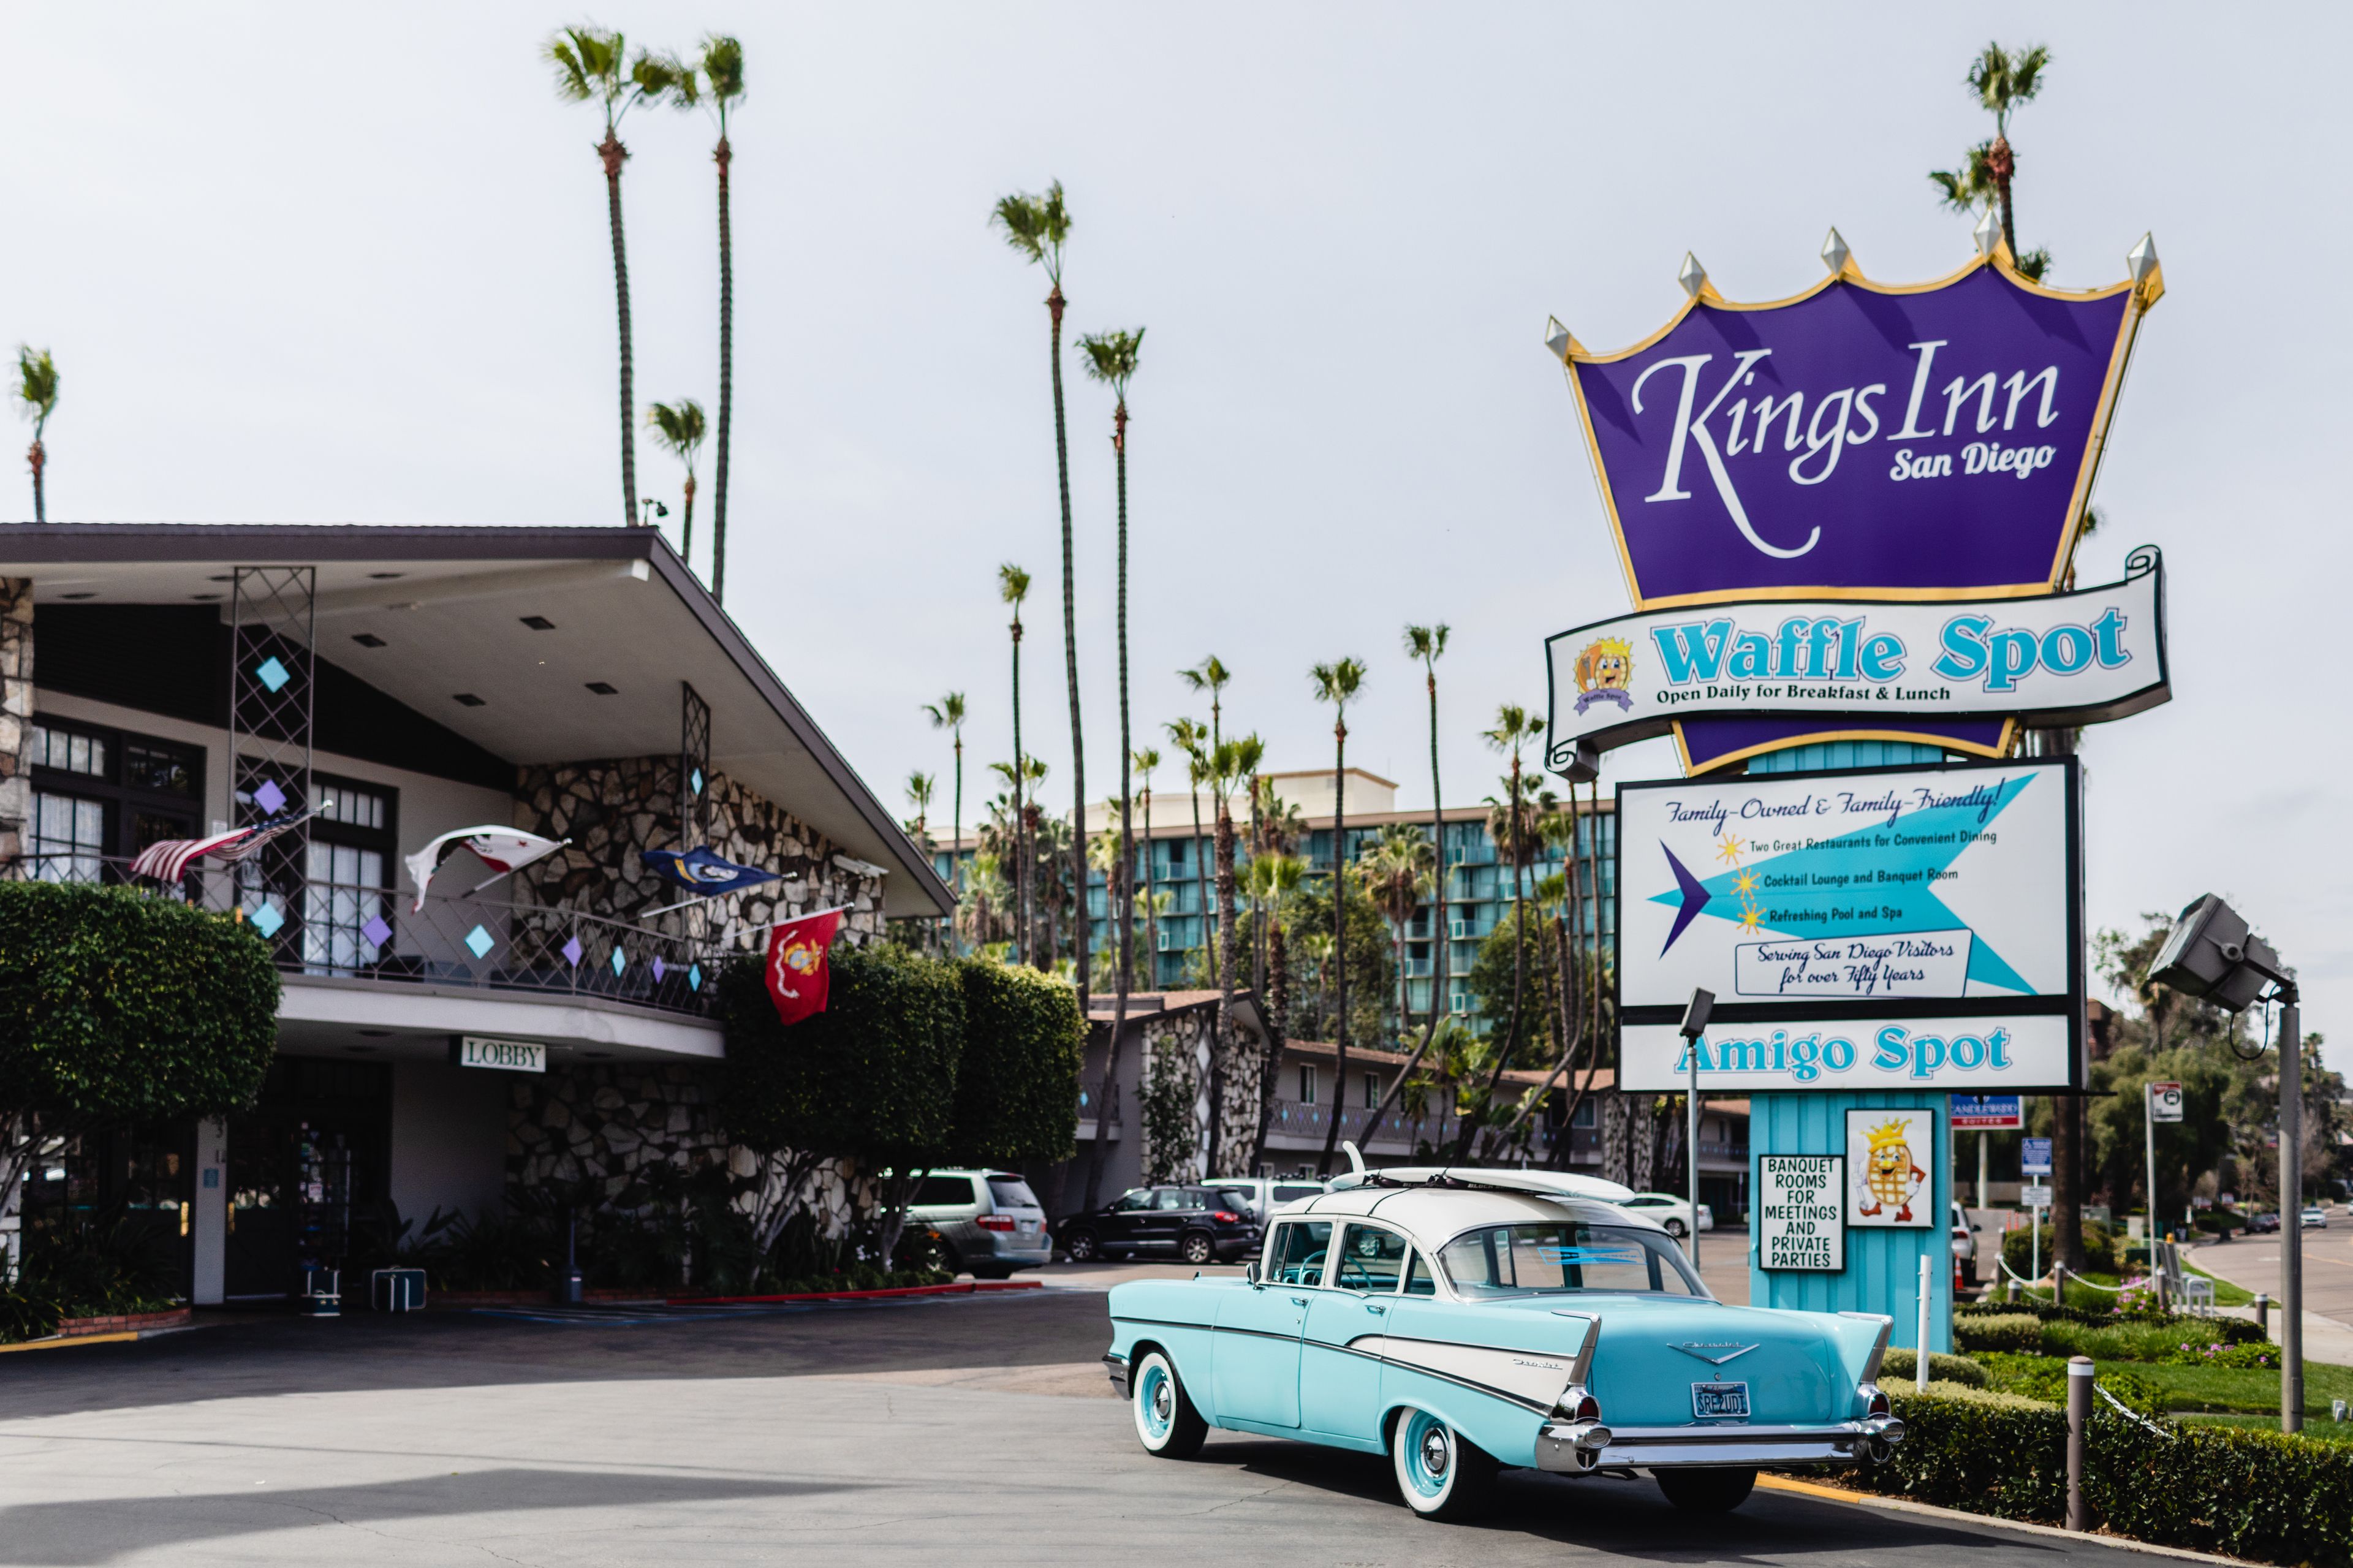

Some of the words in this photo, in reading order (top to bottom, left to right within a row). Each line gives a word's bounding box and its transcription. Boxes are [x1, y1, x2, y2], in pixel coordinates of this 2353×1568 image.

[1631, 348, 1886, 559] Kings
[1886, 339, 2059, 441] Inn
[1889, 448, 1952, 482] San
[1960, 441, 2057, 480] Diego
[1650, 615, 1908, 686] Waffle
[1930, 607, 2133, 693] Spot
[1656, 690, 1700, 705] Open
[1707, 684, 1751, 700] Daily
[1756, 684, 1782, 698] for
[1787, 685, 1870, 700] Breakfast
[1875, 687, 1890, 700] &
[1895, 686, 1951, 700] Lunch
[1665, 794, 1812, 837] Family-Owned
[1815, 798, 1832, 814] &
[1836, 777, 2006, 828] Family-Friendly!
[1750, 841, 1769, 852] Two
[1773, 840, 1802, 851] Great
[1806, 837, 1871, 850] Restaurants
[1874, 834, 1890, 847] for
[1894, 832, 1956, 846] Convenient
[1960, 830, 1997, 844] Dining
[1764, 874, 1808, 888] Cocktail
[1812, 872, 1849, 888] Lounge
[1853, 870, 1873, 884] and
[1877, 869, 1923, 885] Banquet
[1927, 867, 1958, 880] Room
[1770, 909, 1827, 924] Refreshing
[1832, 907, 1854, 920] Pool
[1858, 906, 1878, 919] and
[1882, 905, 1903, 922] Spa
[1757, 944, 1811, 973] Serving
[1814, 942, 1841, 960] San
[1847, 942, 1893, 971] Diego
[1892, 939, 1954, 958] Visitors
[1779, 966, 1803, 994] for
[1808, 974, 1839, 983] over
[1843, 964, 1878, 995] Fifty
[1882, 964, 1925, 991] Years
[468, 1042, 540, 1067] LOBBY
[1673, 1029, 1859, 1084] Amigo
[1870, 1025, 2013, 1080] Spot
[1952, 1104, 2018, 1114] ANDLEWOOD
[1768, 1158, 1835, 1173] BANQUET
[1775, 1174, 1827, 1189] ROOMS
[1787, 1189, 1815, 1204] FOR
[1765, 1205, 1837, 1220] MEETINGS
[1786, 1221, 1816, 1235] AND
[1771, 1236, 1830, 1251] PRIVATE
[1771, 1252, 1831, 1267] PARTIES
